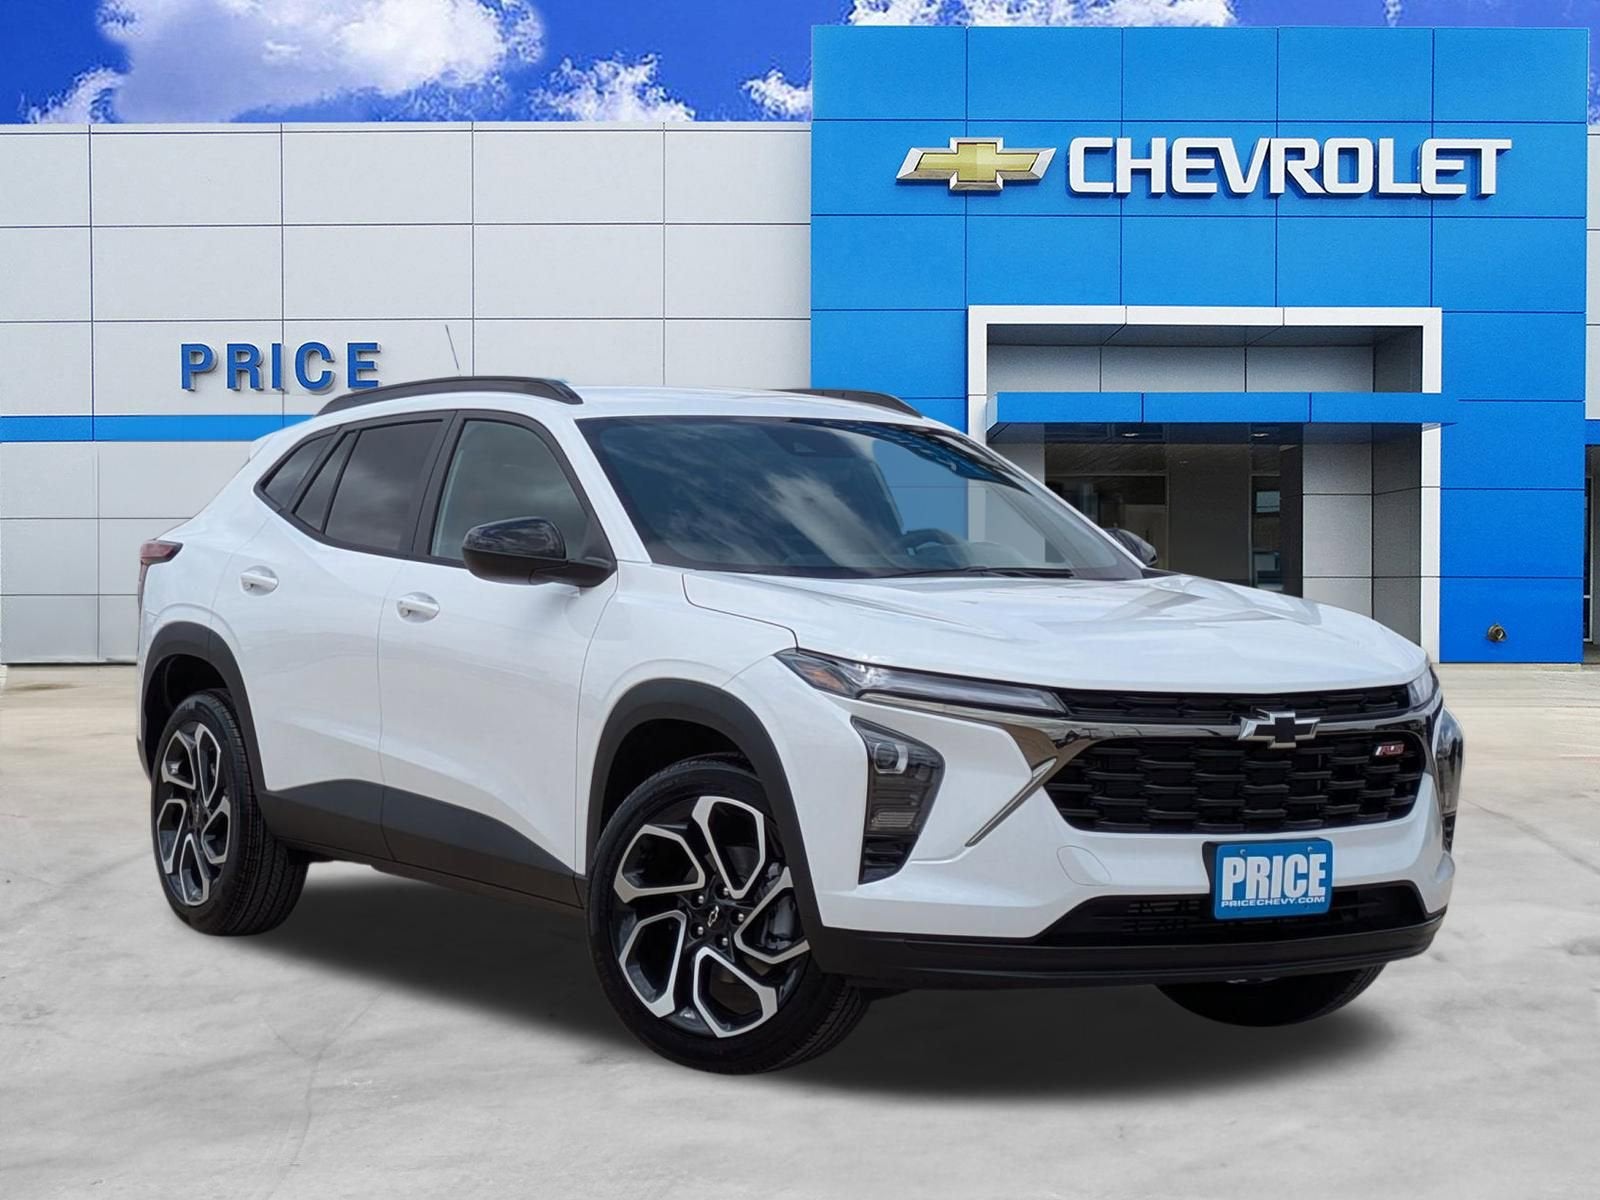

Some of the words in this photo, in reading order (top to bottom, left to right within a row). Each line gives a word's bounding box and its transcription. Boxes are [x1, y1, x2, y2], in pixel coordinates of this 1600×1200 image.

[1069, 137, 1512, 195] CHEVROLET
[181, 341, 381, 393] PRICE
[1221, 896, 1325, 908] PRICECHEVY.COM
[1222, 853, 1327, 901] PRICE
